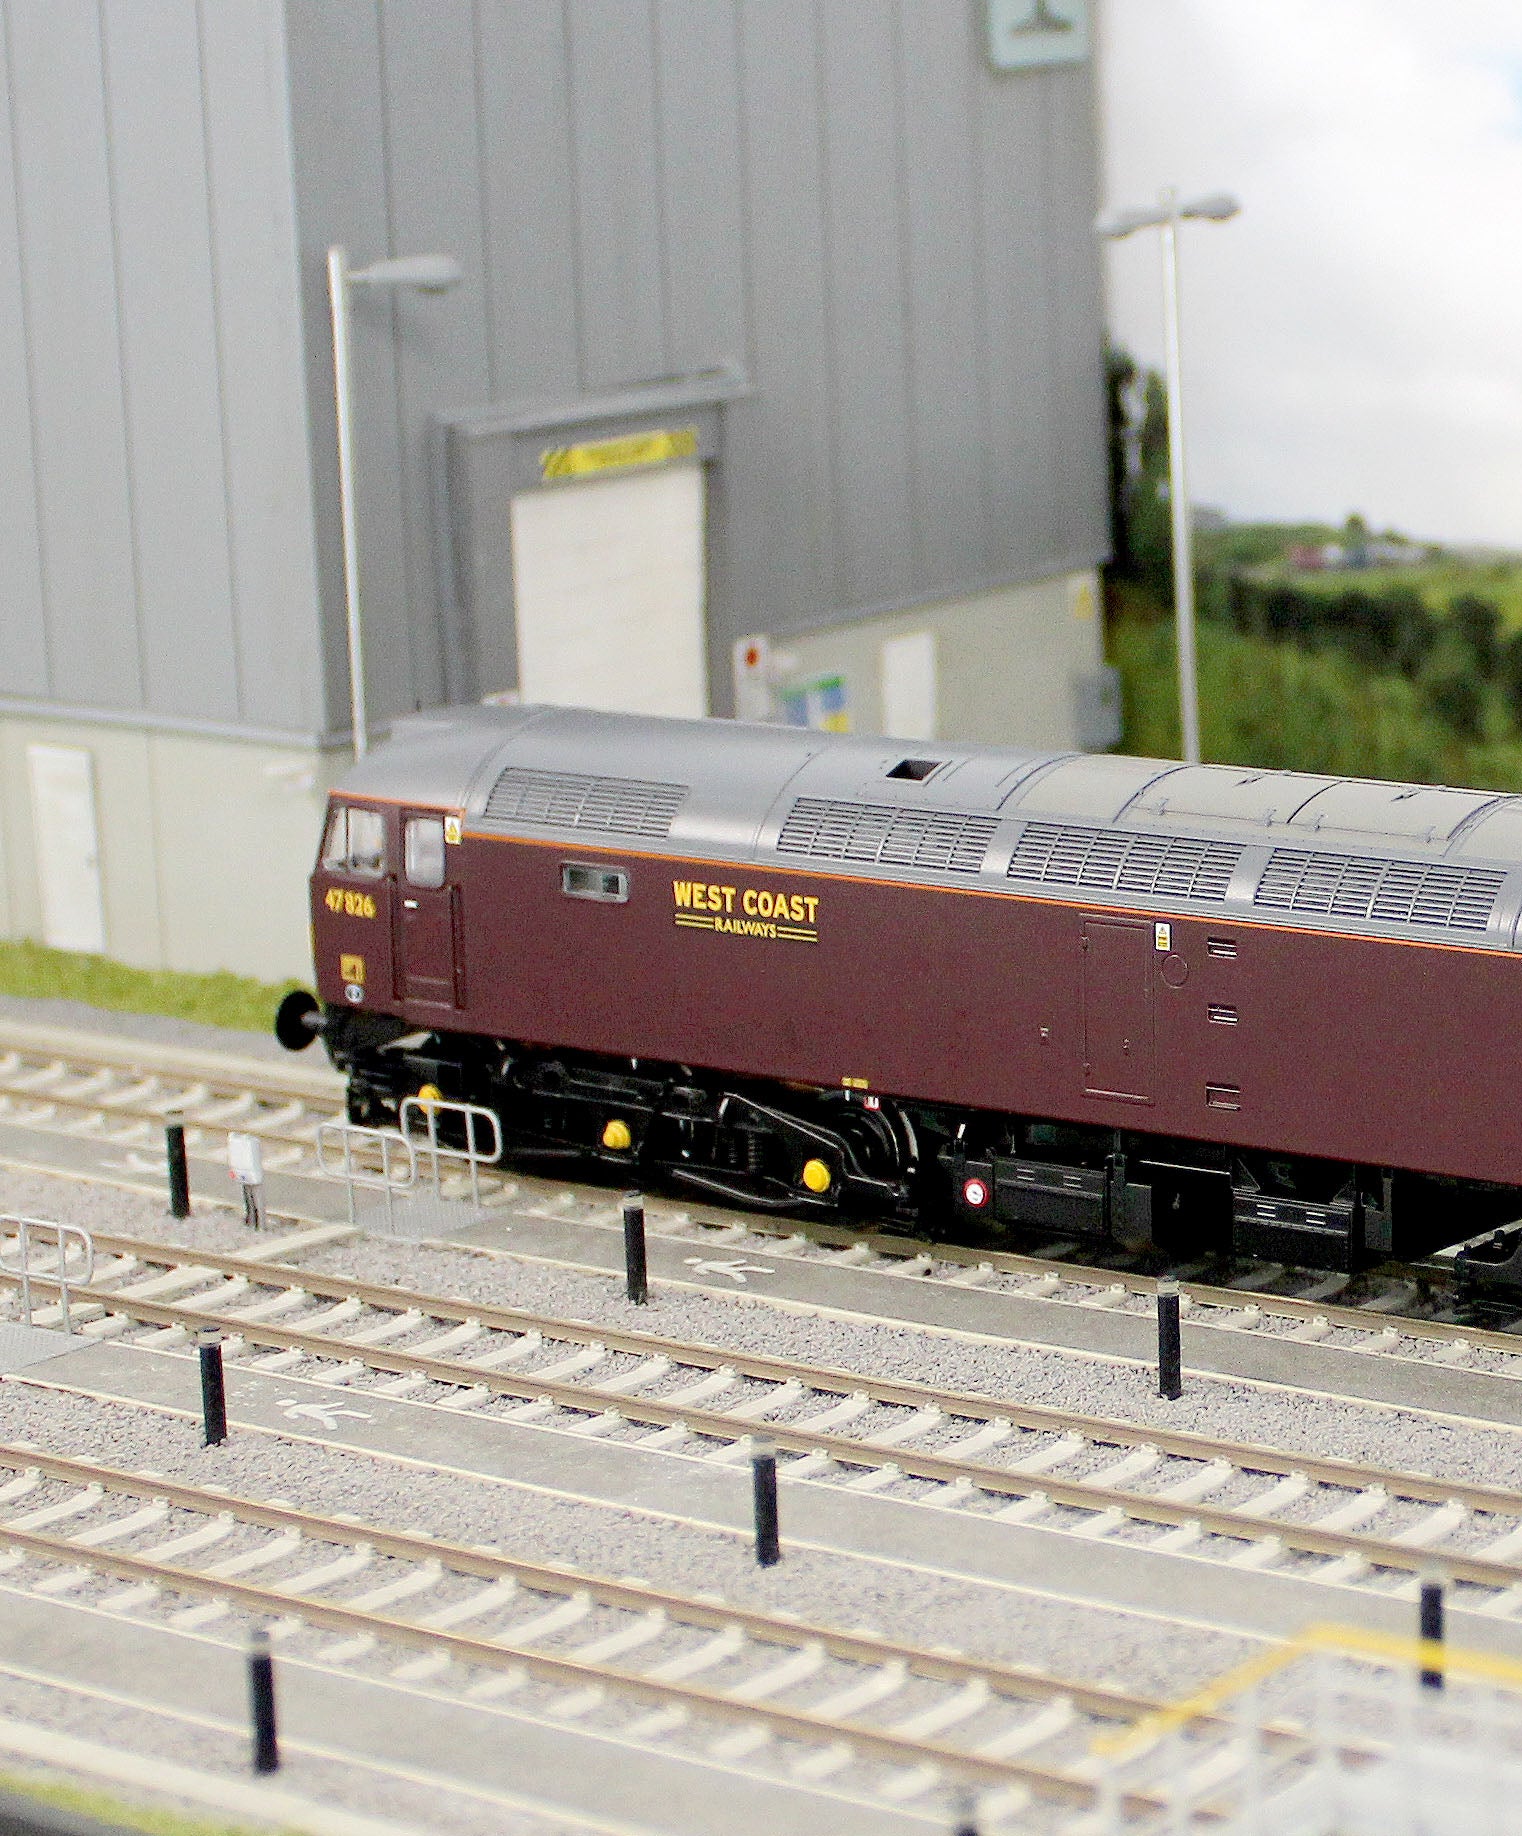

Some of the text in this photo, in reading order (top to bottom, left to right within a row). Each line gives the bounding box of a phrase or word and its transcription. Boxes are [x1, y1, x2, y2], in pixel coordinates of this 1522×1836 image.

[673, 880, 819, 923] WEST COAST
[714, 916, 777, 939] RAILWAYS
